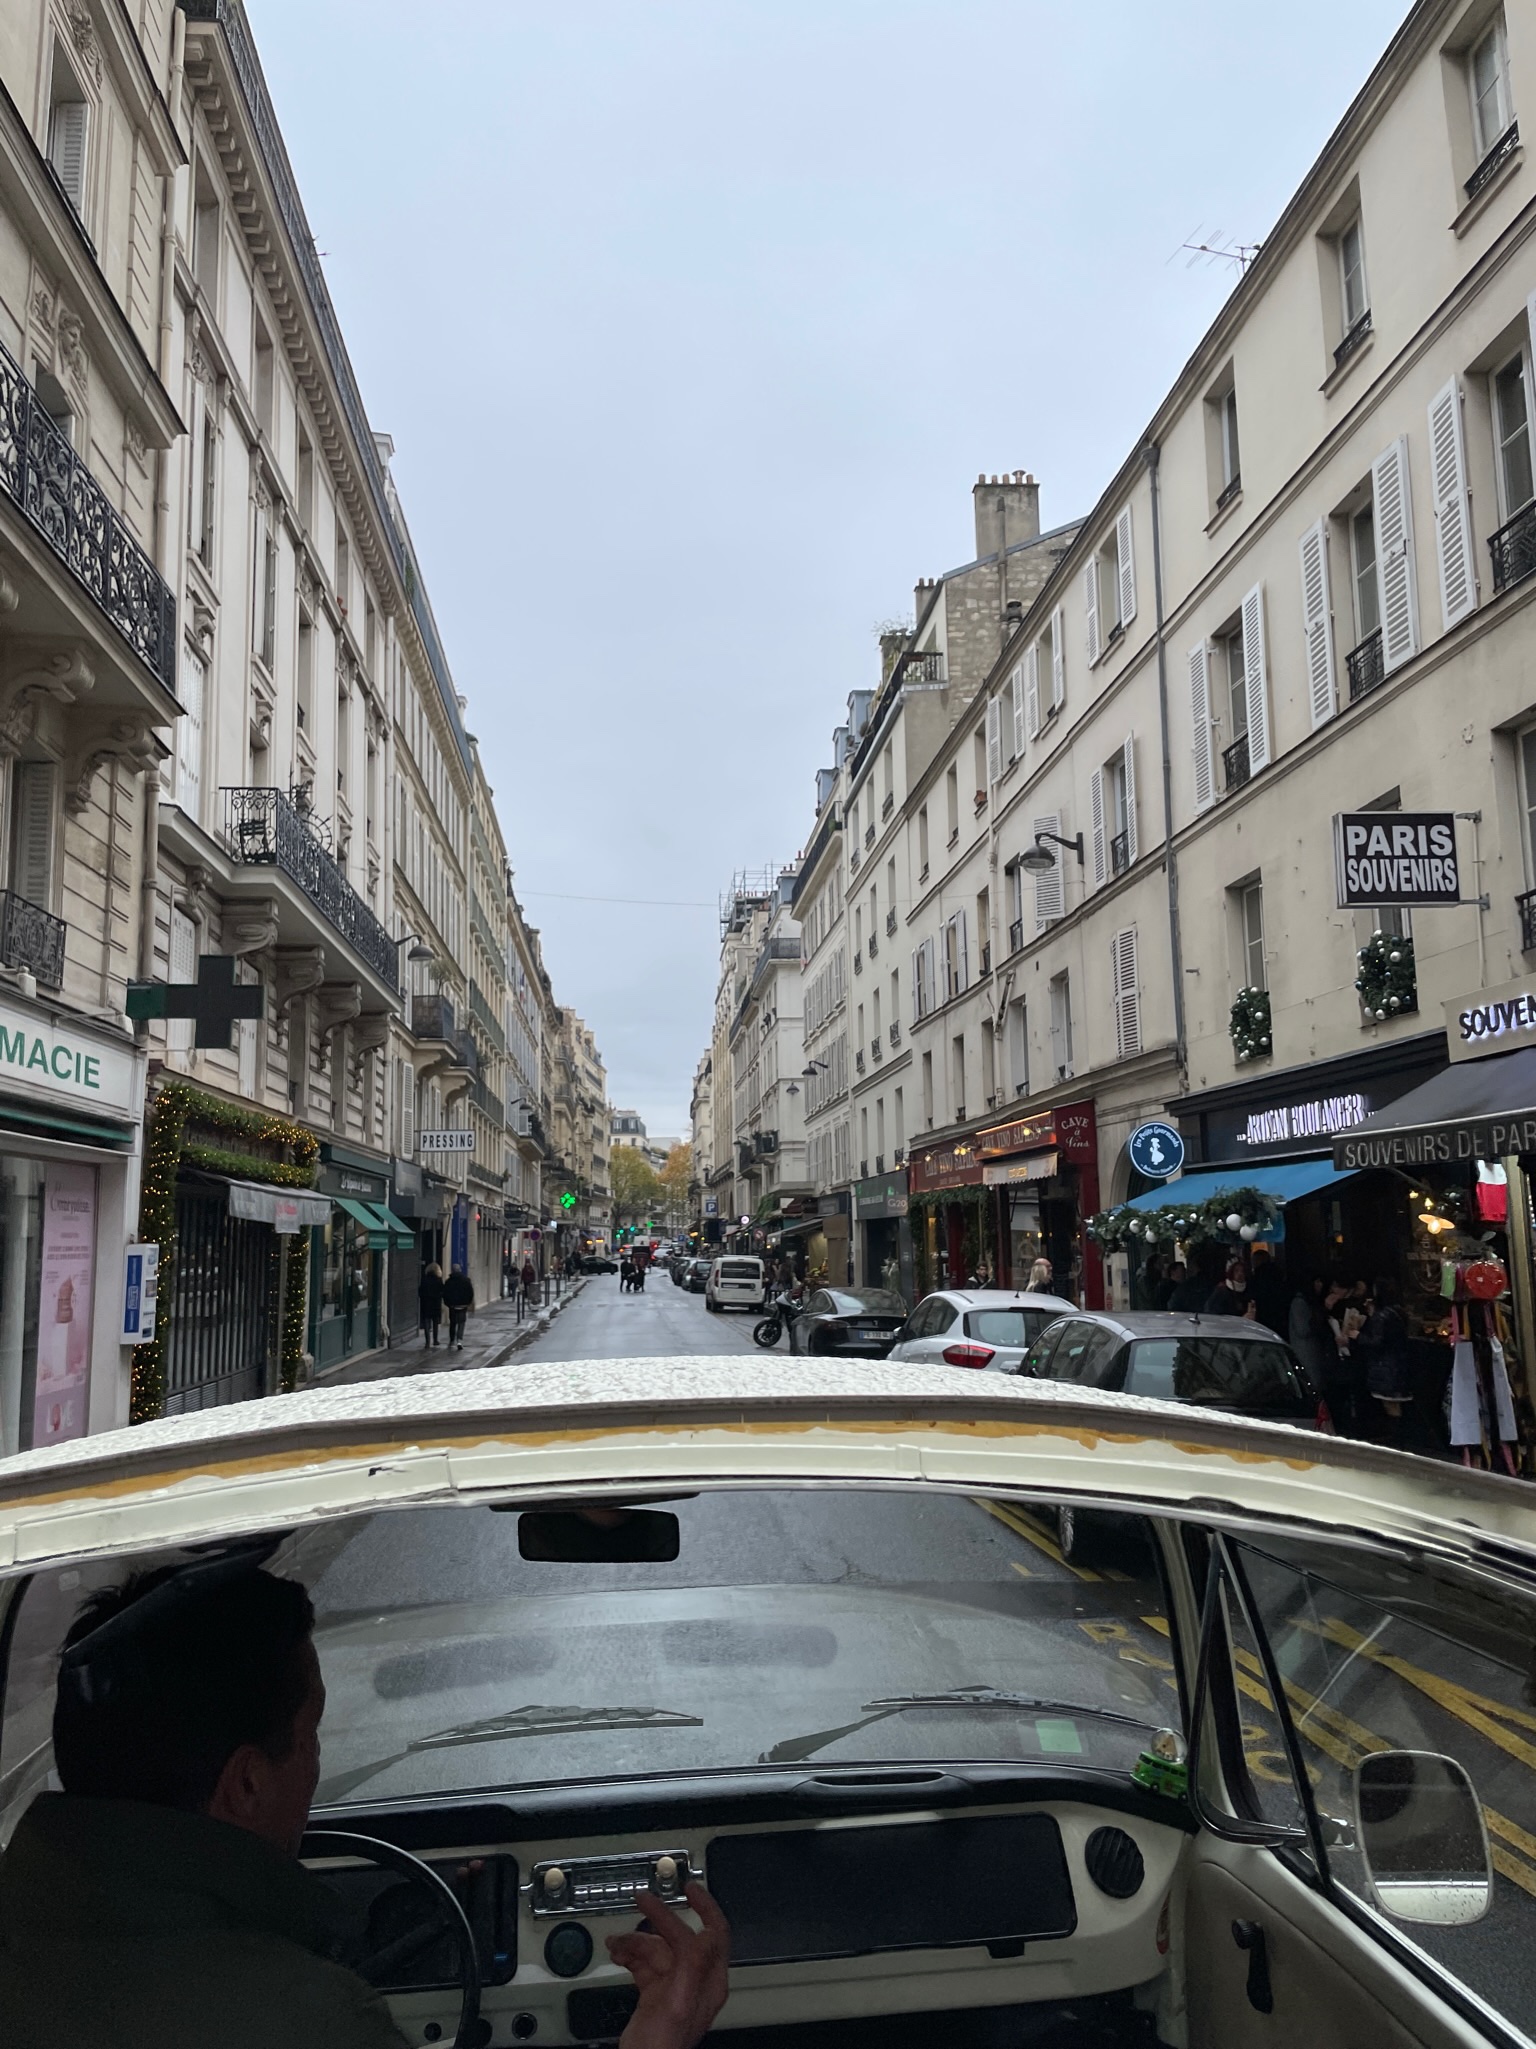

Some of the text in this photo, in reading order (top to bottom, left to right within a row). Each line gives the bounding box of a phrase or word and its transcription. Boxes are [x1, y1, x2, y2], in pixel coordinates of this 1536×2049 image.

[1346, 825, 1453, 856] PARIS
[1347, 858, 1457, 892] SOUVENIRS
[0, 1025, 100, 1089] MACIE
[1061, 1116, 1089, 1130] CAVE
[1247, 1094, 1364, 1144] ARTISAN BOULANGER
[422, 1134, 473, 1148] PRESSING
[1065, 1136, 1090, 1148] Vins
[1153, 1126, 1180, 1148] Gourmands
[1345, 1121, 1536, 1167] SOUVENIRS DE PAR
[888, 1199, 908, 1208] G20
